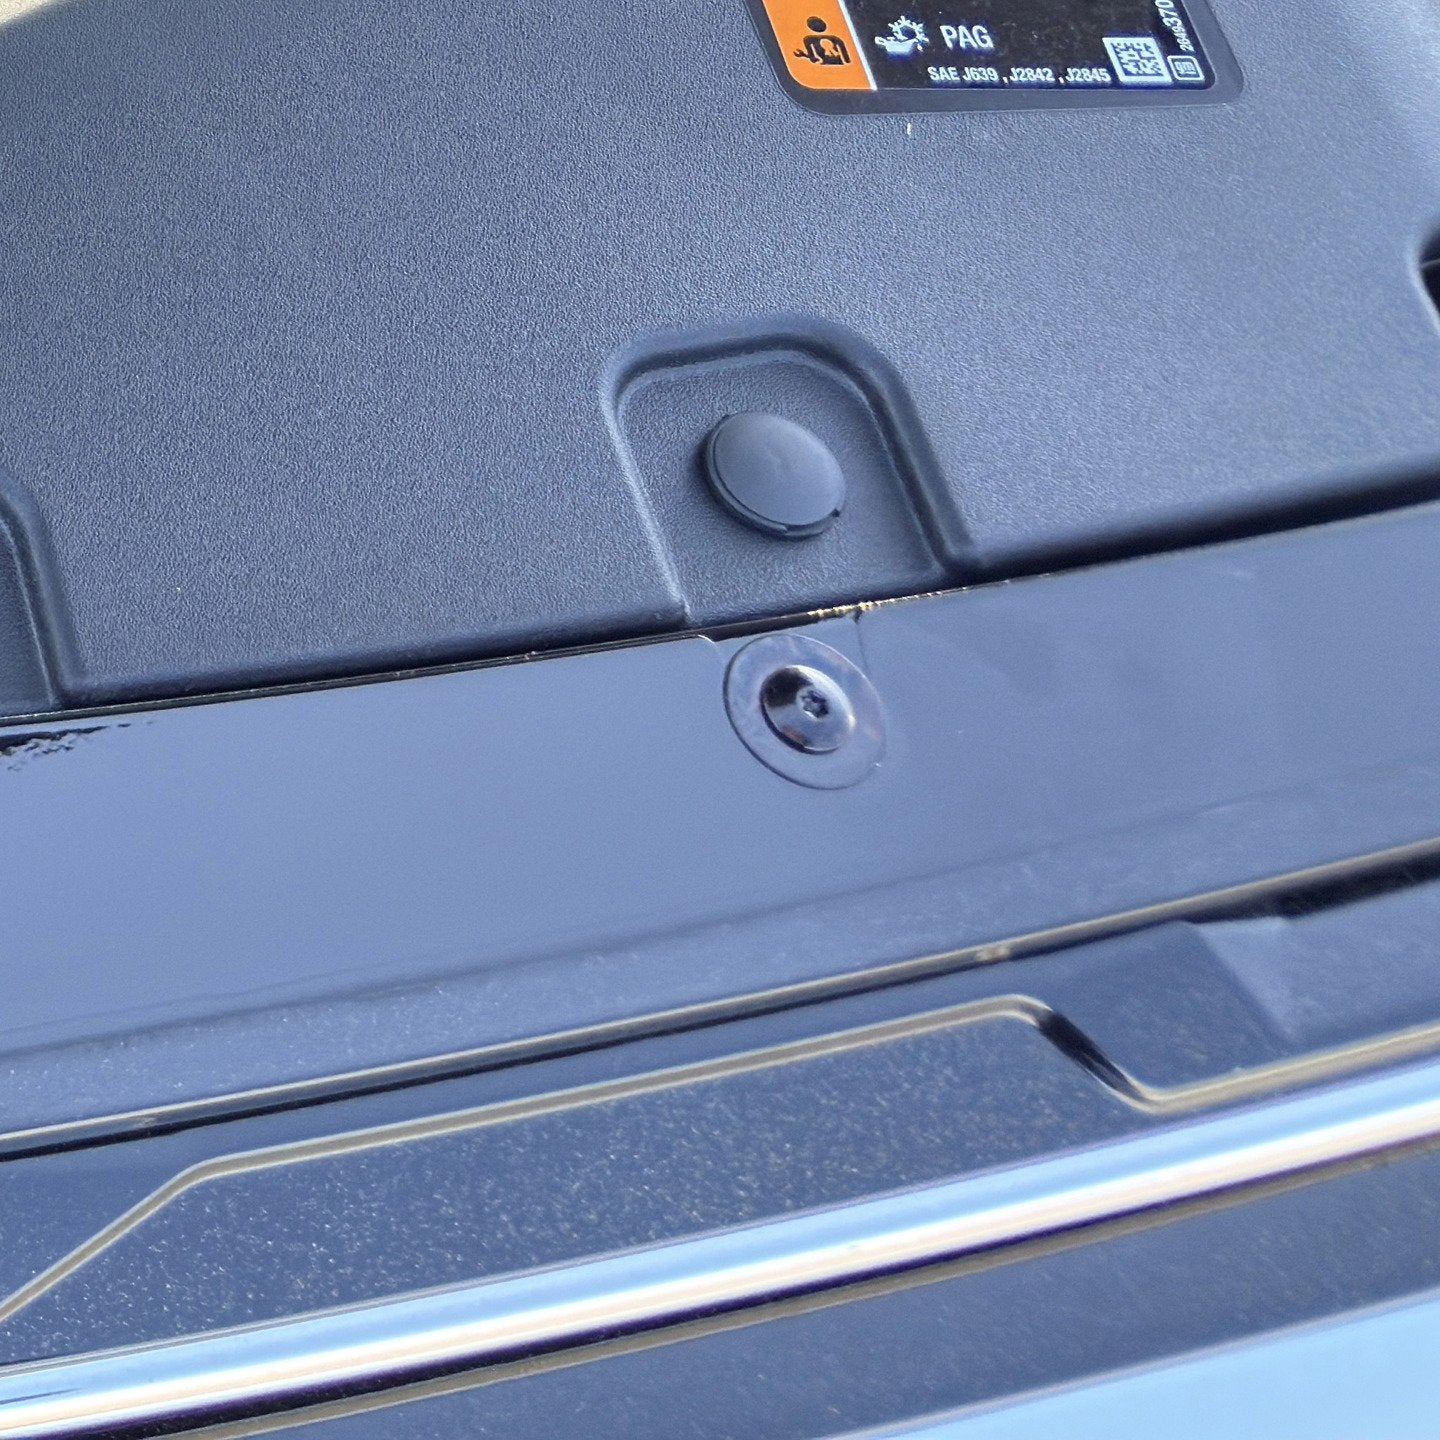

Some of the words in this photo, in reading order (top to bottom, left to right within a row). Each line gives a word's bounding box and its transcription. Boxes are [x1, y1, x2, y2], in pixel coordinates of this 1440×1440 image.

[939, 24, 996, 51] PAG
[928, 66, 958, 82] SAE
[961, 67, 999, 83] J639
